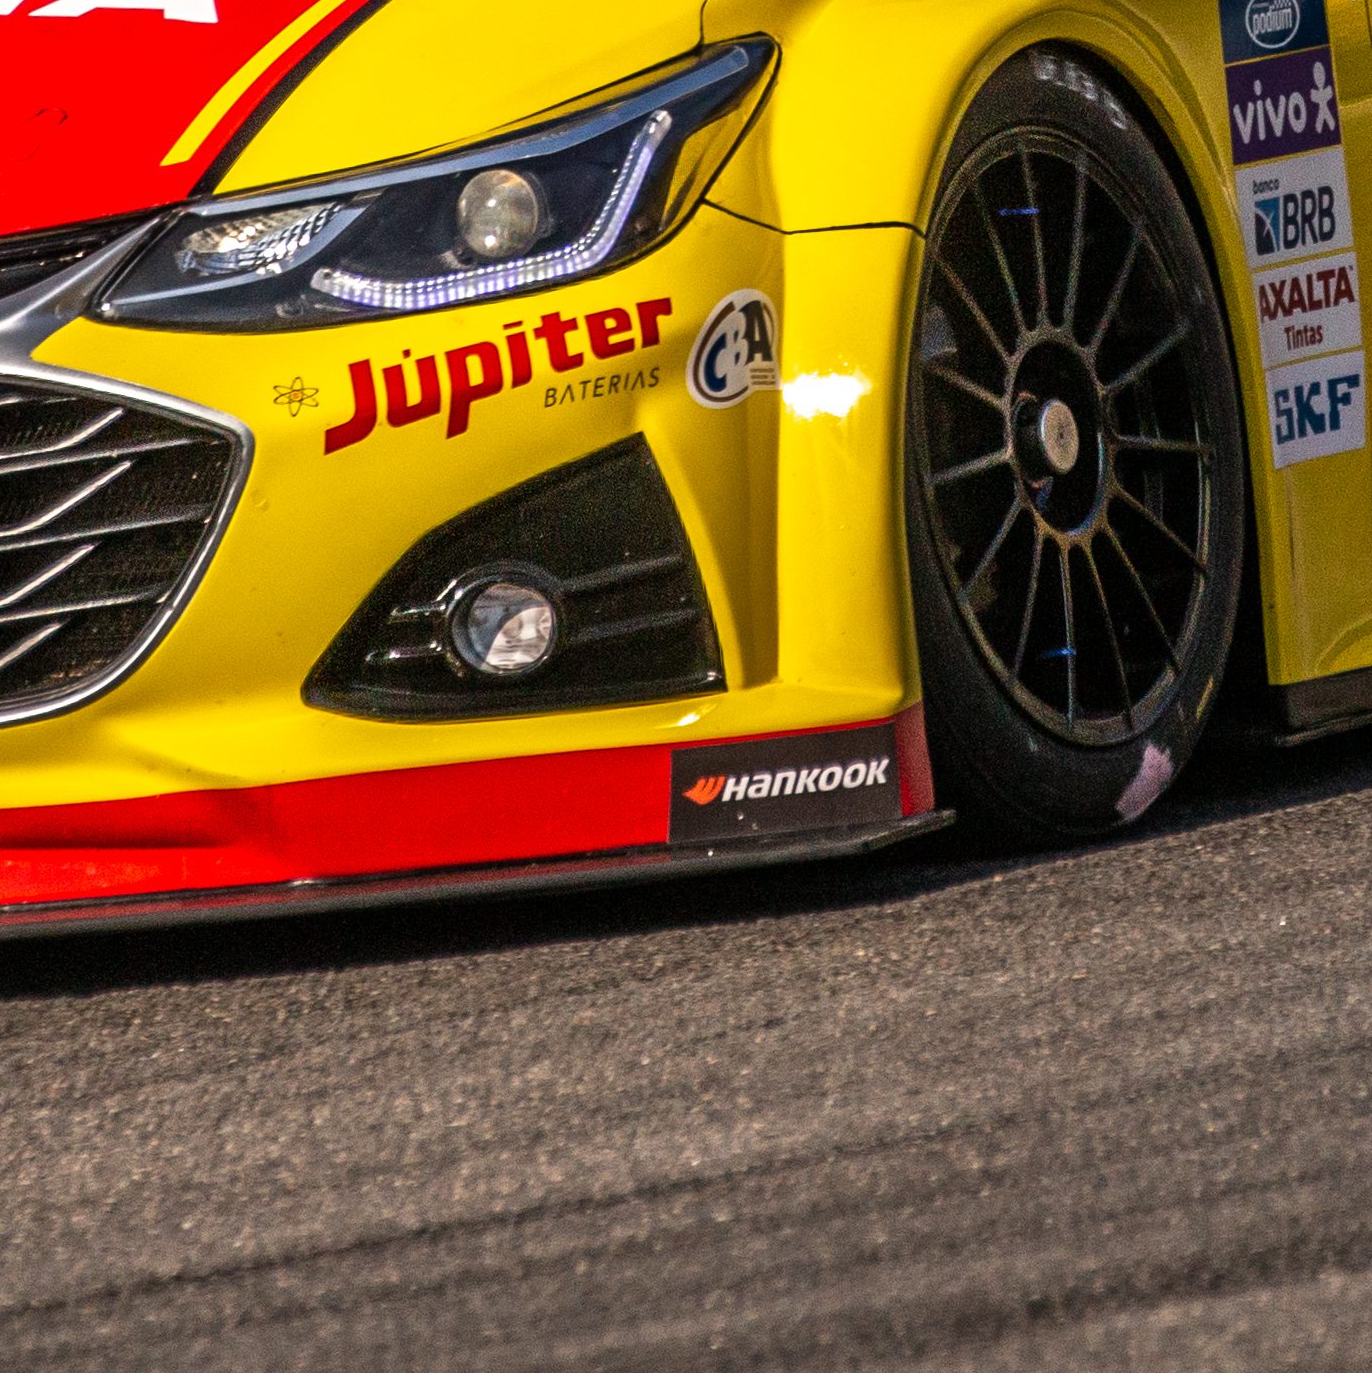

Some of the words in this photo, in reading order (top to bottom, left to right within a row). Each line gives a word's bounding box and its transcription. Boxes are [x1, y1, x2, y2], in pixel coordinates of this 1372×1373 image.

[1252, 7, 1293, 35] podium
[1232, 79, 1307, 145] vivo
[1252, 179, 1280, 195] banco
[1282, 185, 1337, 251] BRB
[1258, 265, 1356, 324] AXALTA
[704, 299, 774, 393] CBA
[1283, 324, 1324, 351] Tintas
[323, 297, 673, 455] Júpiter
[543, 366, 661, 409] BATERIAS
[1275, 374, 1361, 446] SKF
